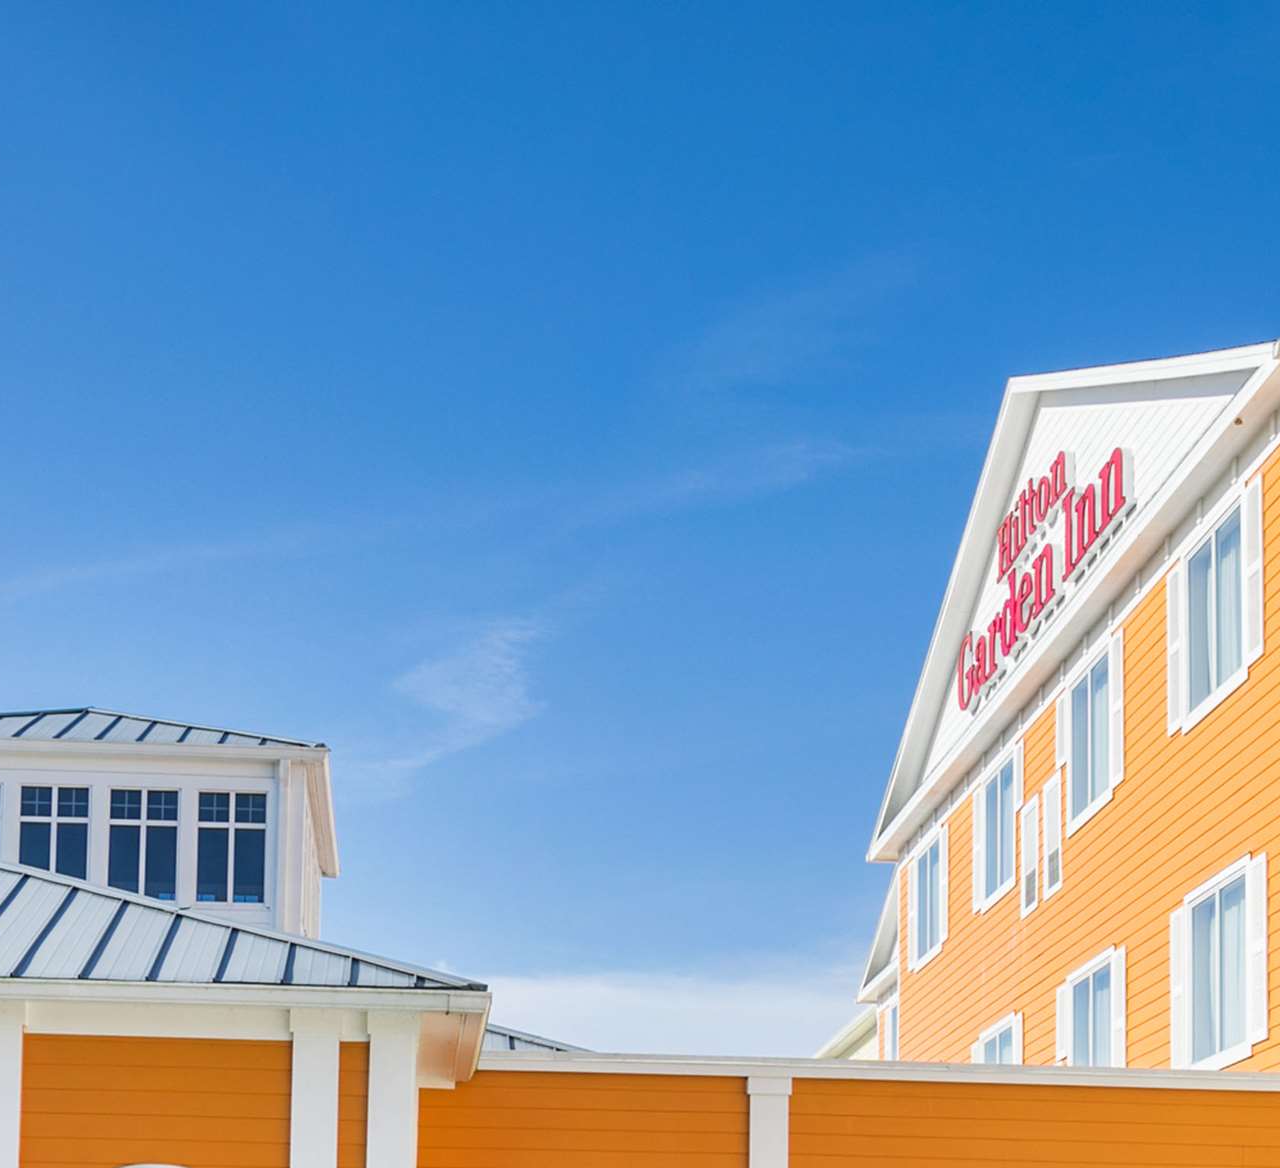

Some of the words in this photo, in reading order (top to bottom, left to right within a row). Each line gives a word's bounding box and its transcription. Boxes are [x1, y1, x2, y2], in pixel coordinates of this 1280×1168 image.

[957, 543, 1056, 711] Garden
[1062, 447, 1126, 583] Inn
[996, 450, 1067, 584] Hilton
